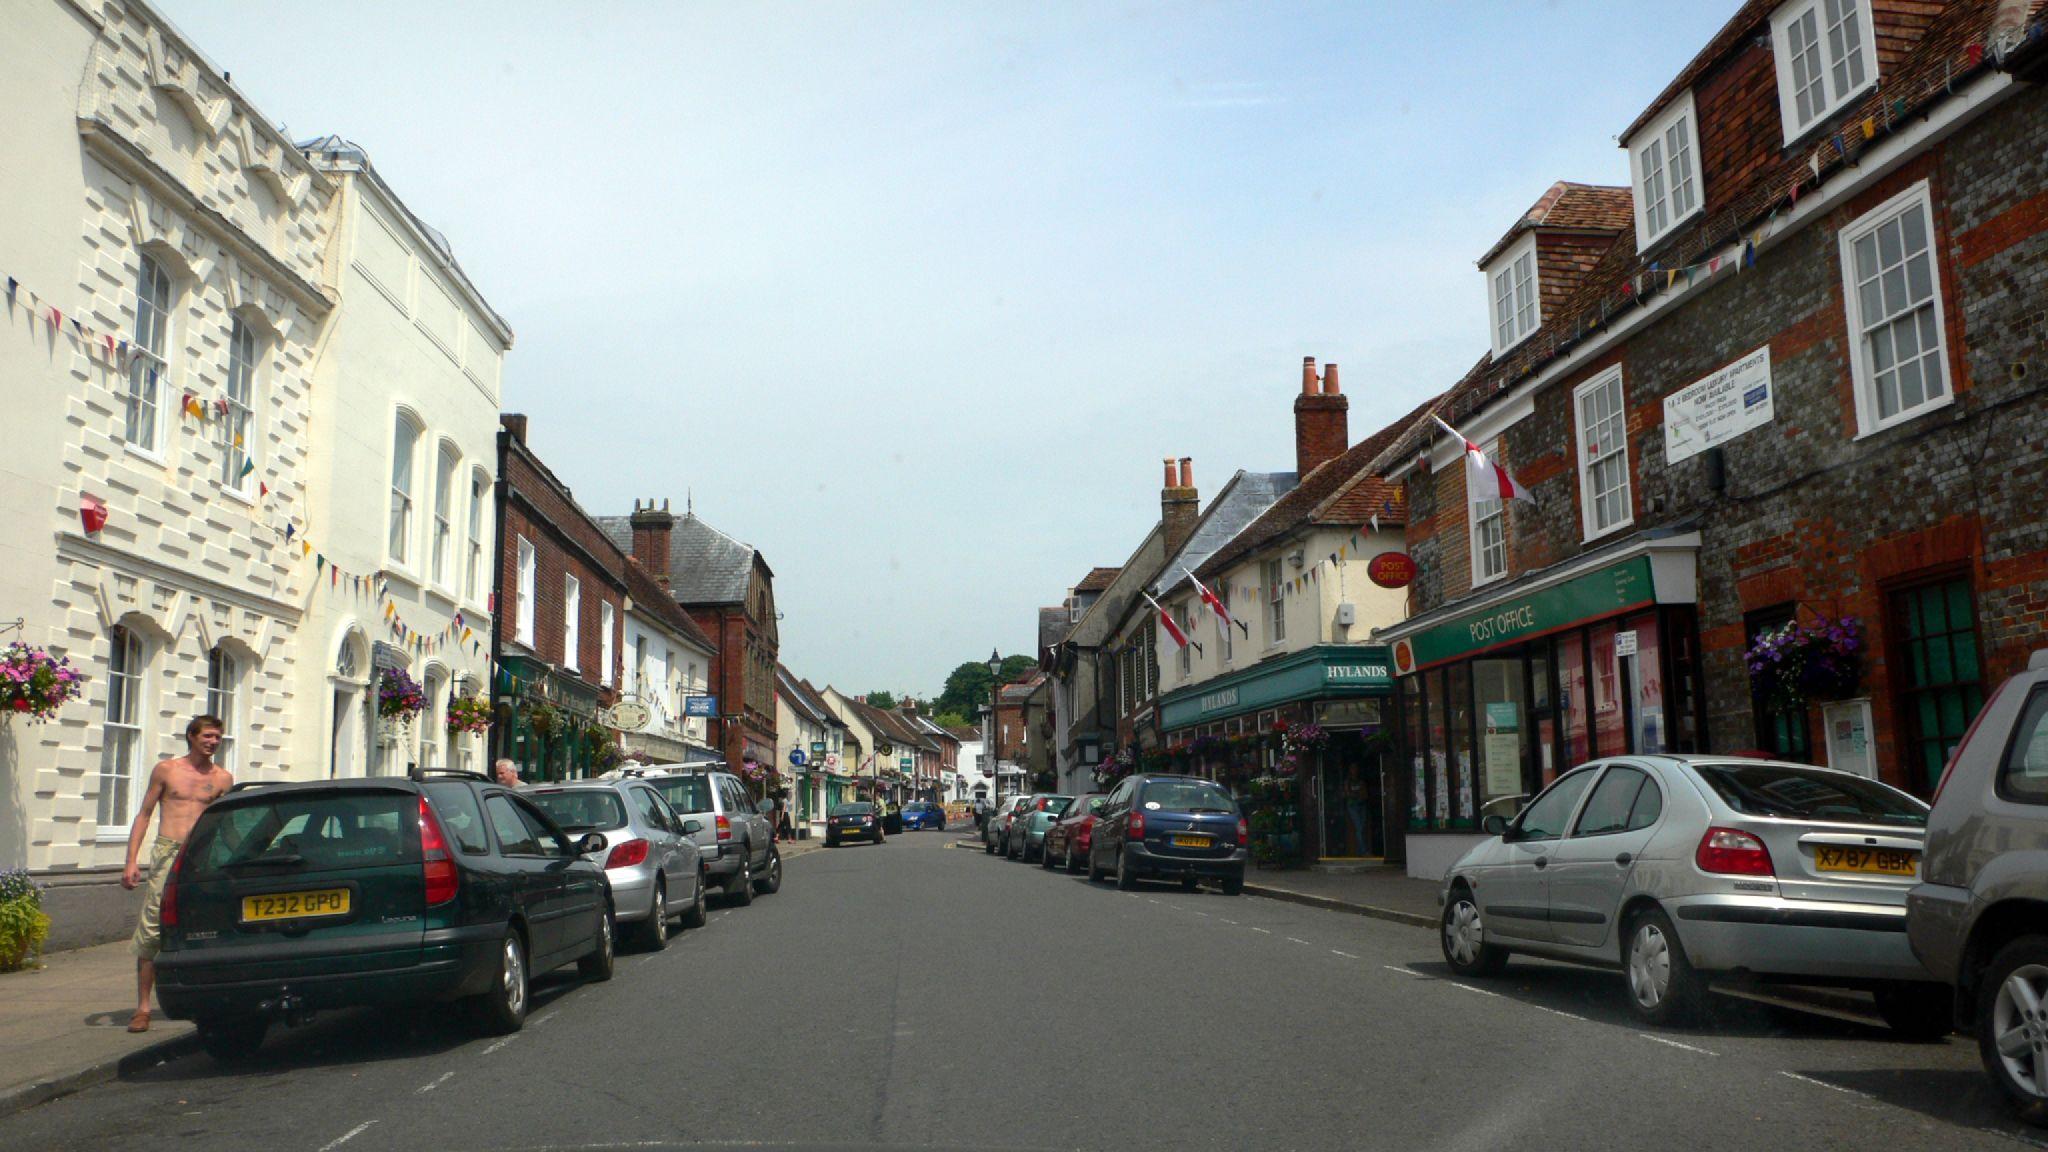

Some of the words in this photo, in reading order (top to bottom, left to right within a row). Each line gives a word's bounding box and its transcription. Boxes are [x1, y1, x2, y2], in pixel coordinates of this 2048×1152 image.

[1681, 384, 1706, 403] BEDROOM
[1706, 372, 1728, 390] LUXURY
[1729, 353, 1765, 378] APARTMENTS
[1694, 394, 1707, 405] NOW
[1708, 379, 1735, 399] AVAILABLE
[1378, 571, 1409, 581] OFFICE
[1381, 561, 1405, 571] POST
[1469, 617, 1495, 643] POST
[1496, 605, 1534, 635] OFFICE
[1327, 665, 1388, 678] HYLANDS
[1201, 687, 1238, 713] HYLANDS
[1819, 849, 1872, 869] X787
[1877, 852, 1914, 872] GBK
[252, 896, 299, 916] T232
[304, 893, 341, 911] GPO
